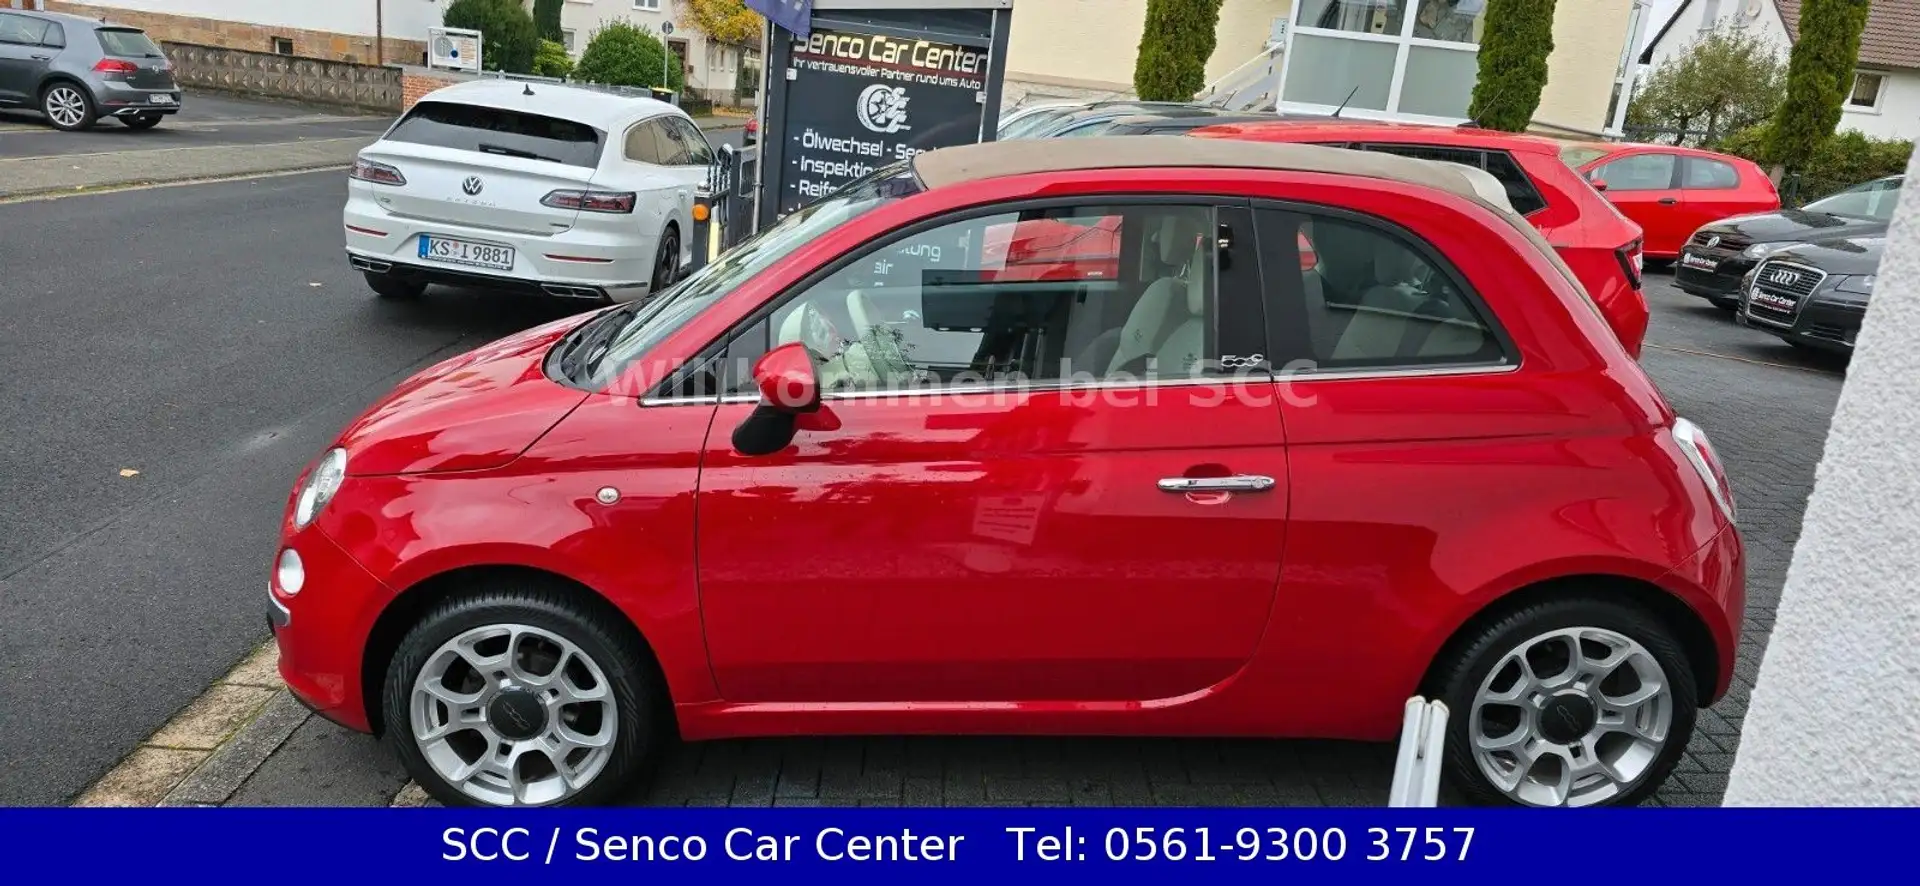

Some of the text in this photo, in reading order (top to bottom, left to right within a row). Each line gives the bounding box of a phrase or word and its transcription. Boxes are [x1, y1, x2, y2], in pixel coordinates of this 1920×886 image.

[868, 35, 908, 64] Car
[911, 40, 988, 74] Center
[793, 56, 981, 90] Ihr vertrauensvoller Partner rund ums Auto
[802, 127, 884, 157] Ölwechsel
[429, 239, 450, 256] KS
[460, 244, 468, 259] I
[473, 245, 510, 264] 9881
